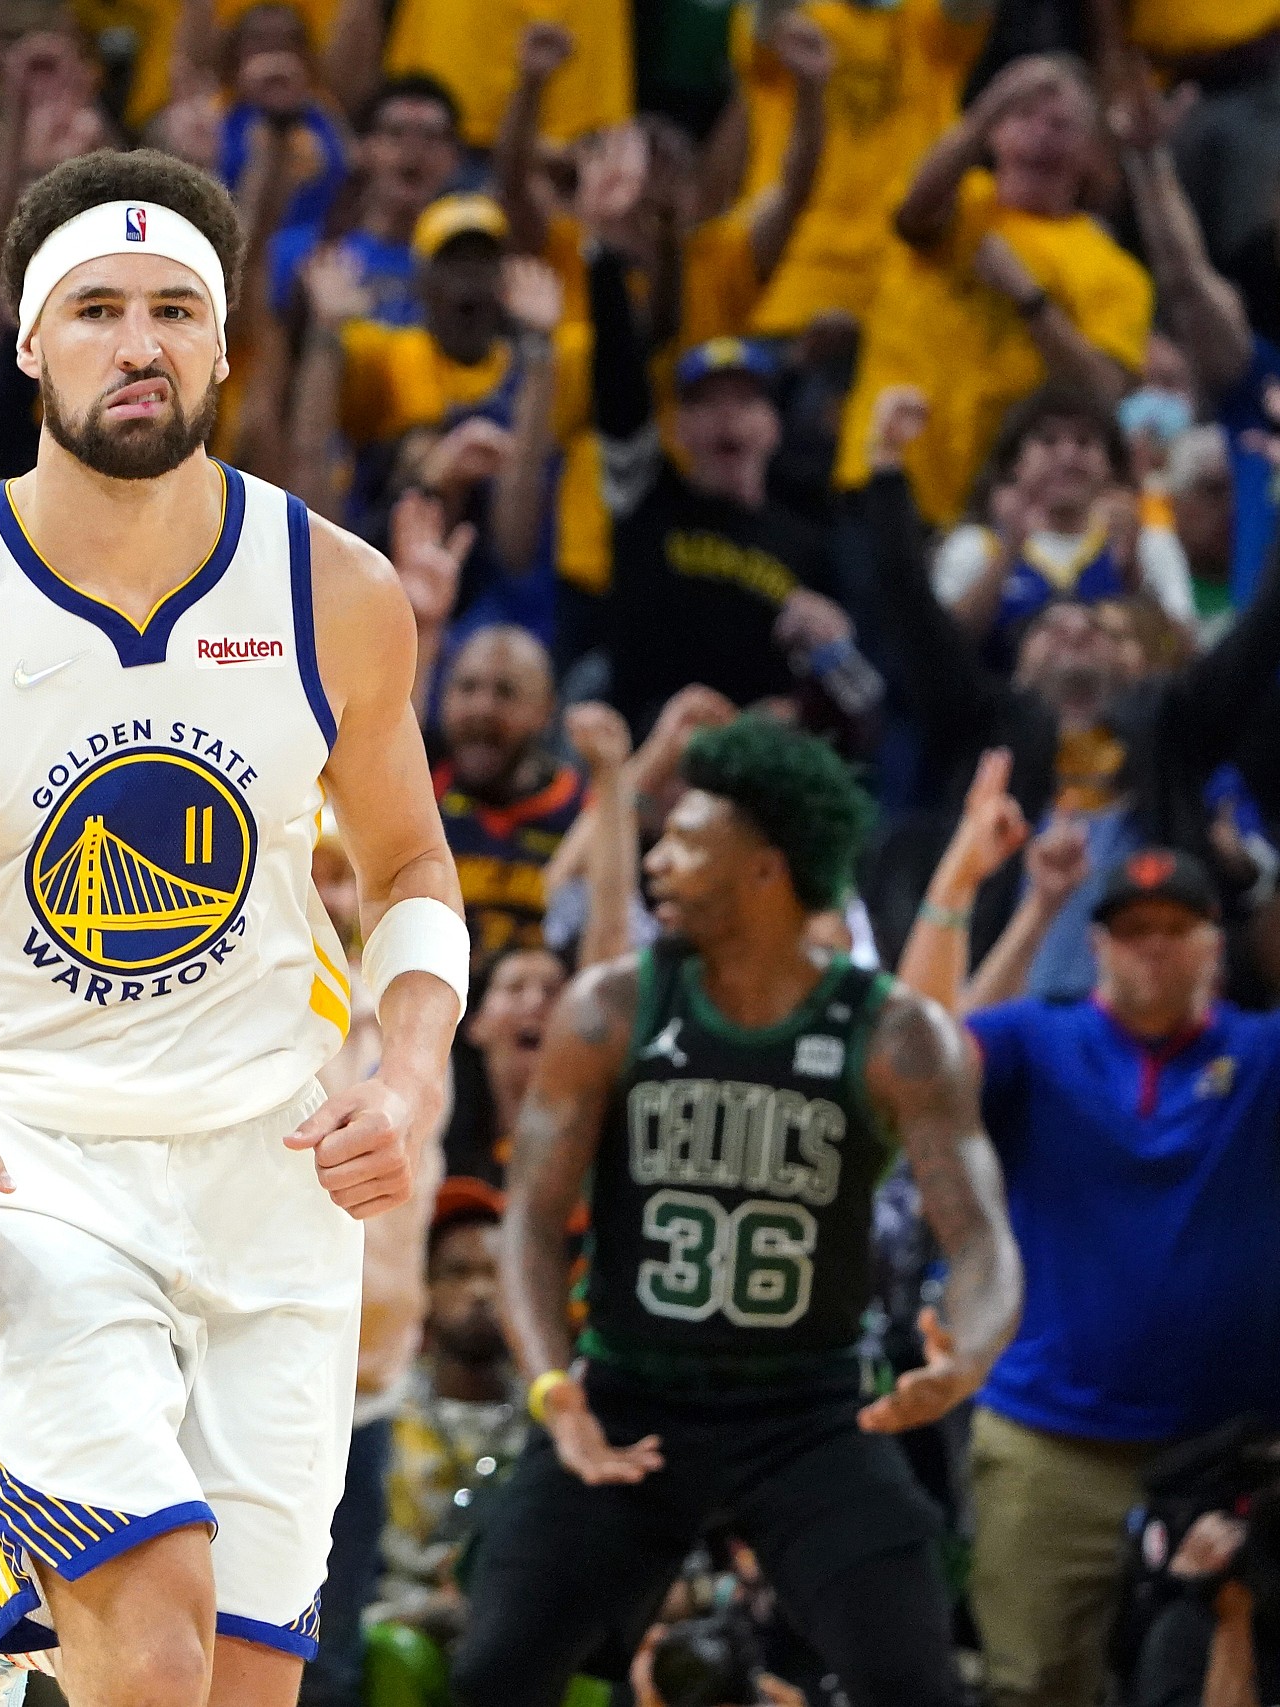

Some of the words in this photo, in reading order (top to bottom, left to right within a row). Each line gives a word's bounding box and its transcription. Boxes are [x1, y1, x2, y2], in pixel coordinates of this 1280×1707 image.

[198, 637, 283, 658] Rakuten
[33, 719, 152, 809] GOLDEN
[170, 722, 258, 790] STATE
[185, 805, 214, 864] 11
[22, 914, 246, 1006] WARRIORS
[627, 1078, 847, 1206] CELTICS
[636, 1189, 818, 1328] 36
